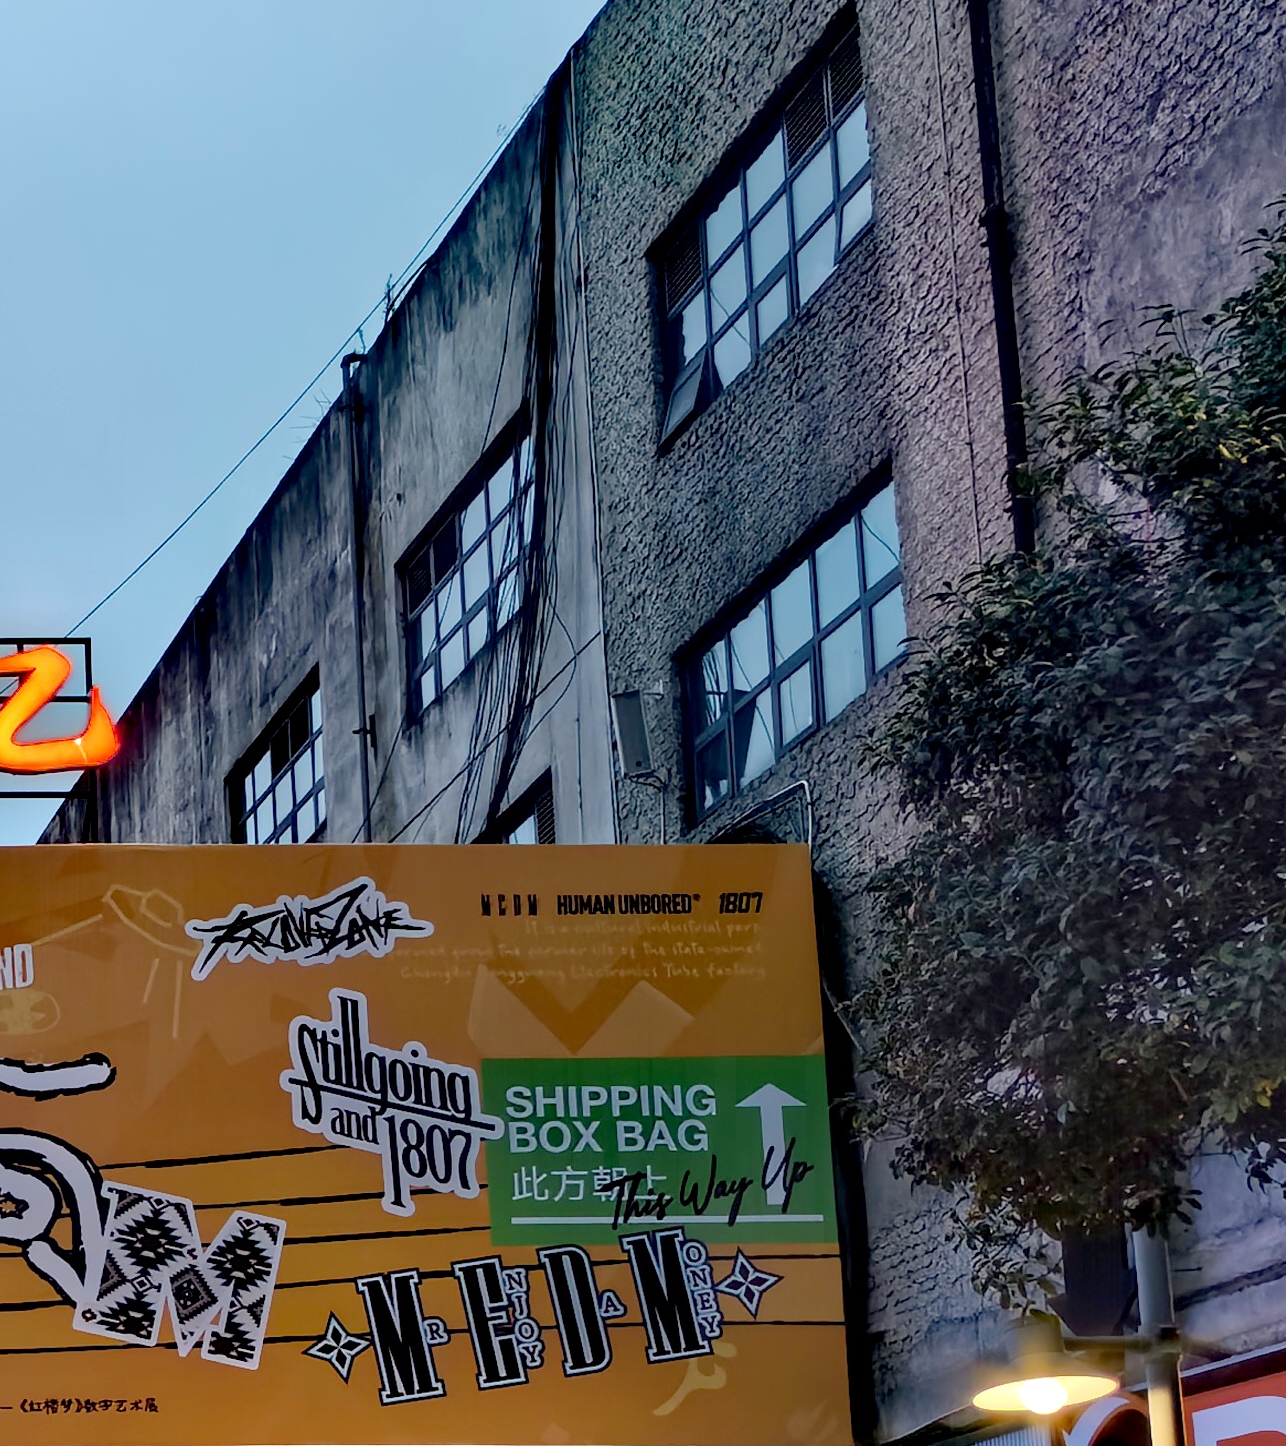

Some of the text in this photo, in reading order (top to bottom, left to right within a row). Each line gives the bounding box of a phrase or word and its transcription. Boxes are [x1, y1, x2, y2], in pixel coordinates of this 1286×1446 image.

[557, 893, 615, 916] HUMAN
[719, 891, 763, 915] 1807
[505, 1084, 717, 1119] SHIPPING
[509, 1119, 709, 1154] BOX BAG
[330, 1106, 472, 1209] and 1807
[600, 1136, 816, 1231] This Way Up
